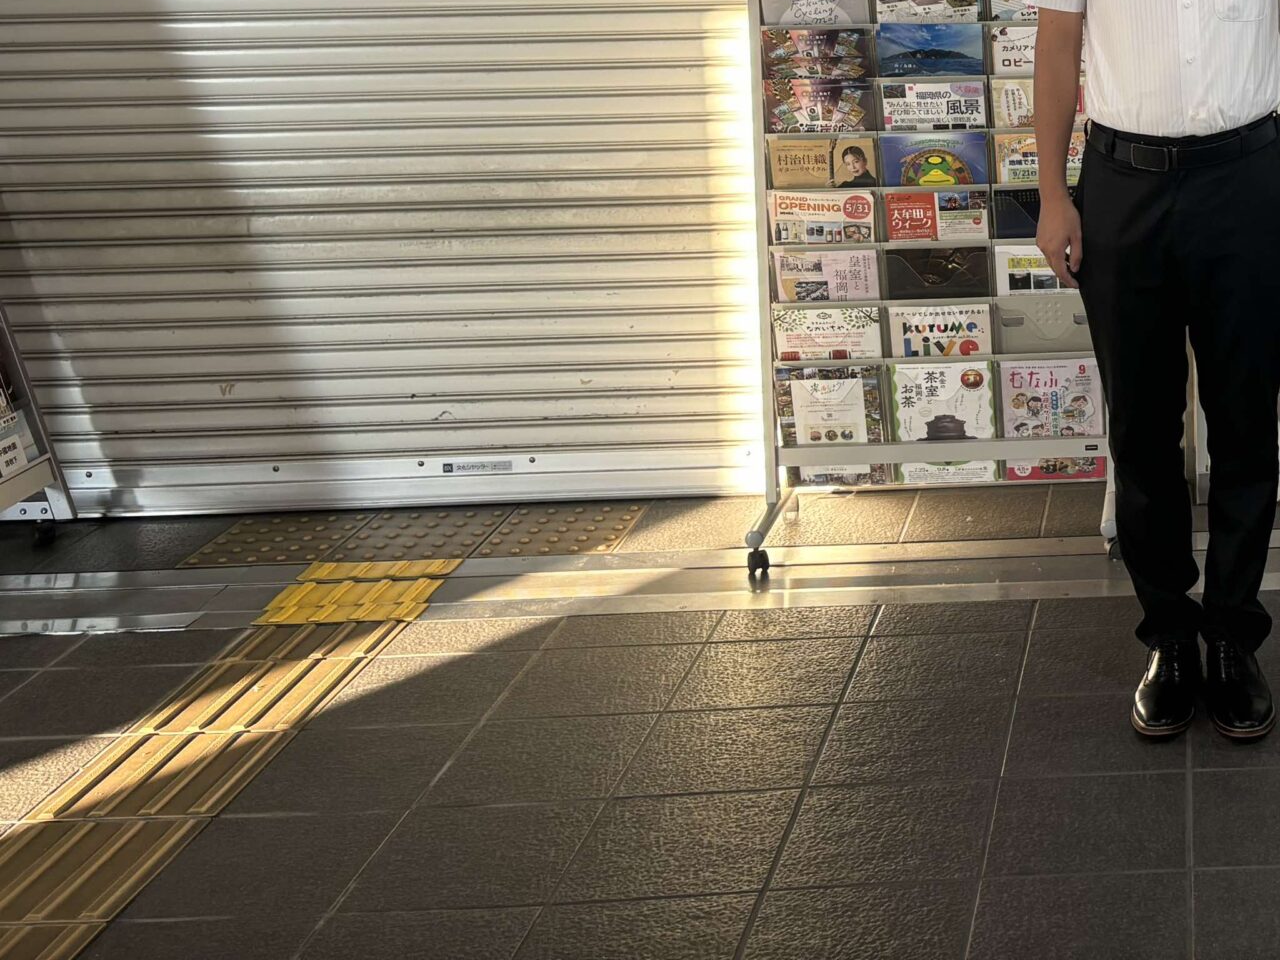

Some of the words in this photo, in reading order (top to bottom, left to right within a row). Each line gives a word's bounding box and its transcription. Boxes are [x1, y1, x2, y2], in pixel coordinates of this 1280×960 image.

[946, 99, 981, 115] 風景
[778, 201, 841, 212] OPENING
[845, 203, 869, 213] 5/31
[892, 208, 924, 219] 大牟田
[1078, 364, 1086, 375] 9
[900, 384, 916, 408] お茶
